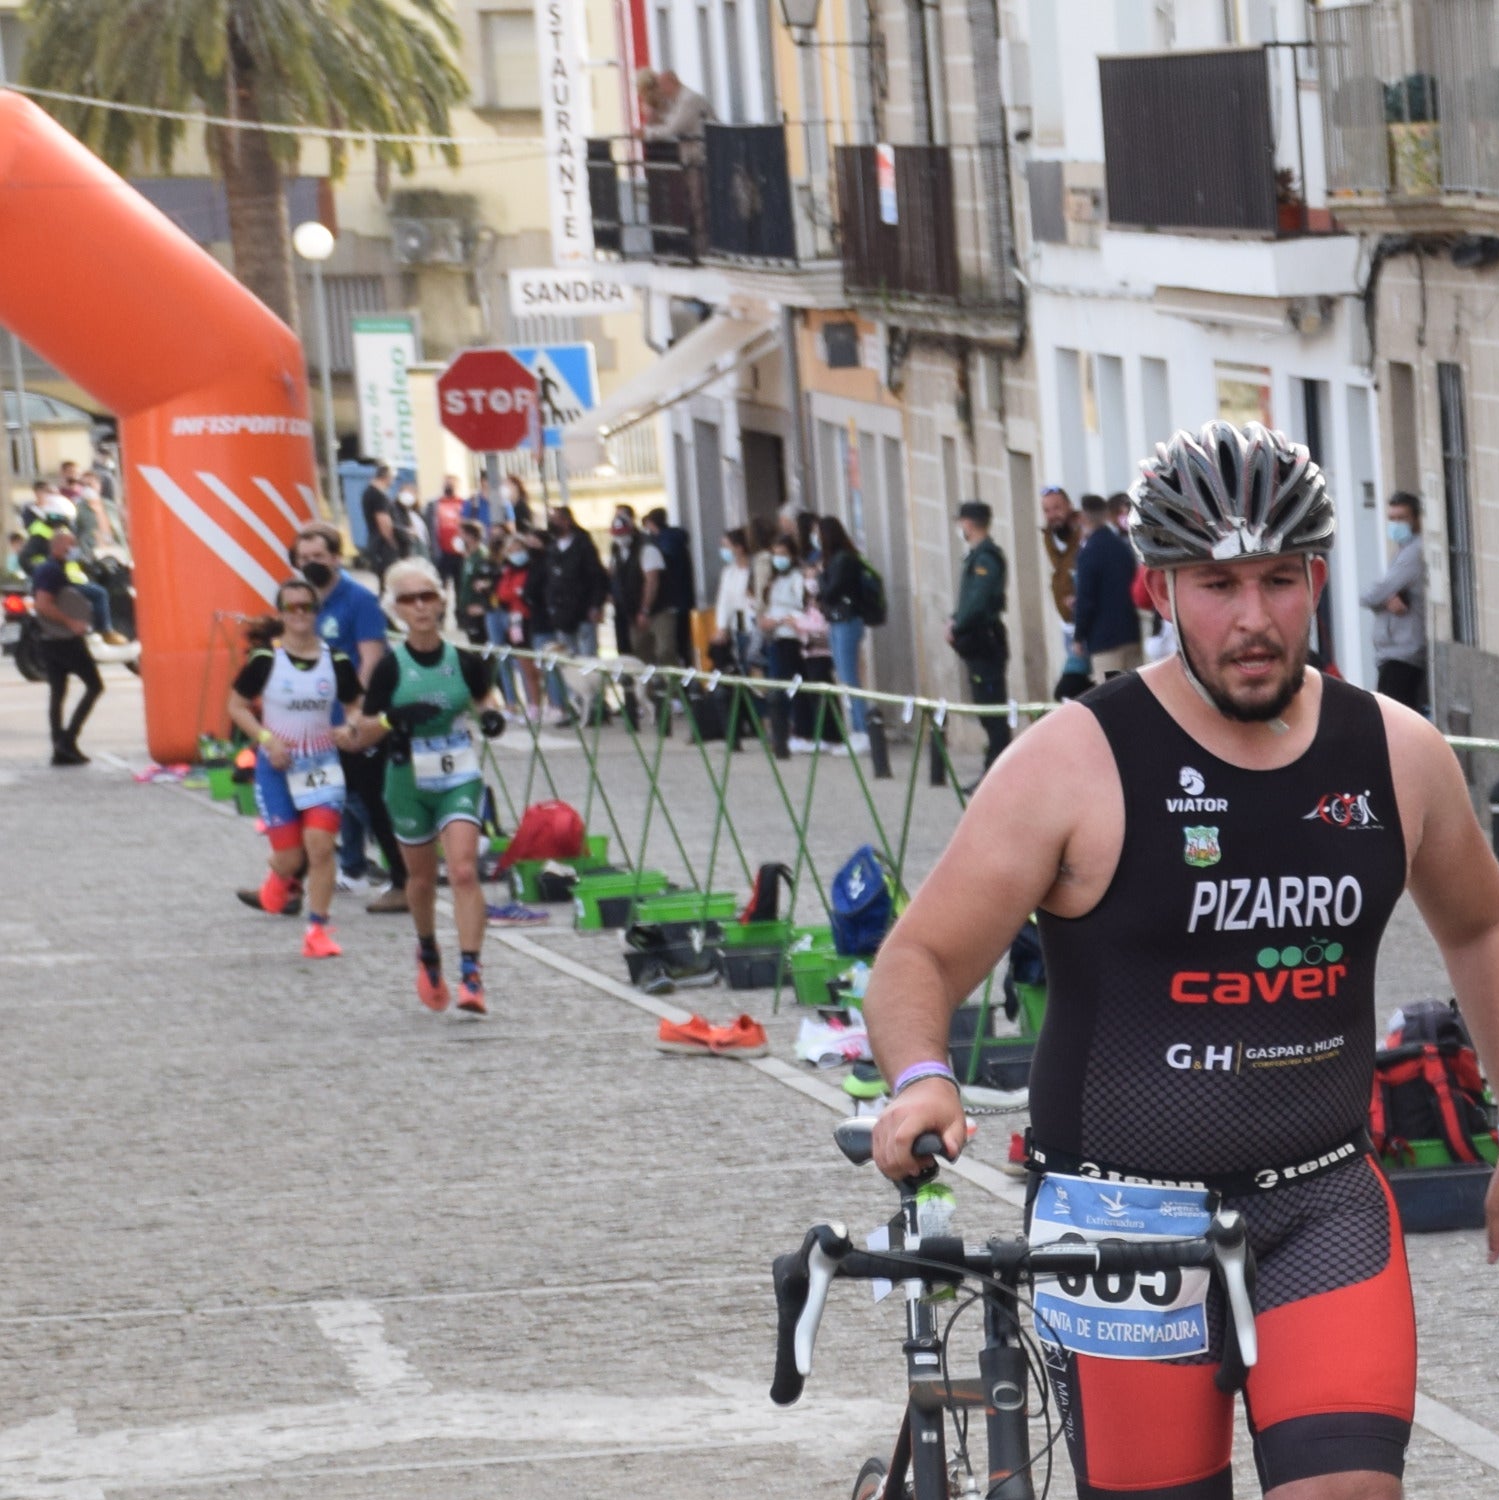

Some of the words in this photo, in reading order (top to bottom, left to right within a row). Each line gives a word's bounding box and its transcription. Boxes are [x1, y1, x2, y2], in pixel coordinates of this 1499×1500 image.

[521, 281, 625, 303] SANDRA
[444, 389, 532, 415] STOP
[441, 754, 454, 775] 6
[1165, 798, 1229, 813] VIATOR
[1187, 875, 1363, 934] PIZARRO
[1170, 965, 1347, 1005] caver
[1246, 1045, 1304, 1059] GASPAR
[1314, 1035, 1345, 1052] HIJOS
[1086, 1215, 1146, 1229] Extremadura
[1076, 1319, 1092, 1339] DE
[1096, 1320, 1201, 1344] EXTREMADURA
